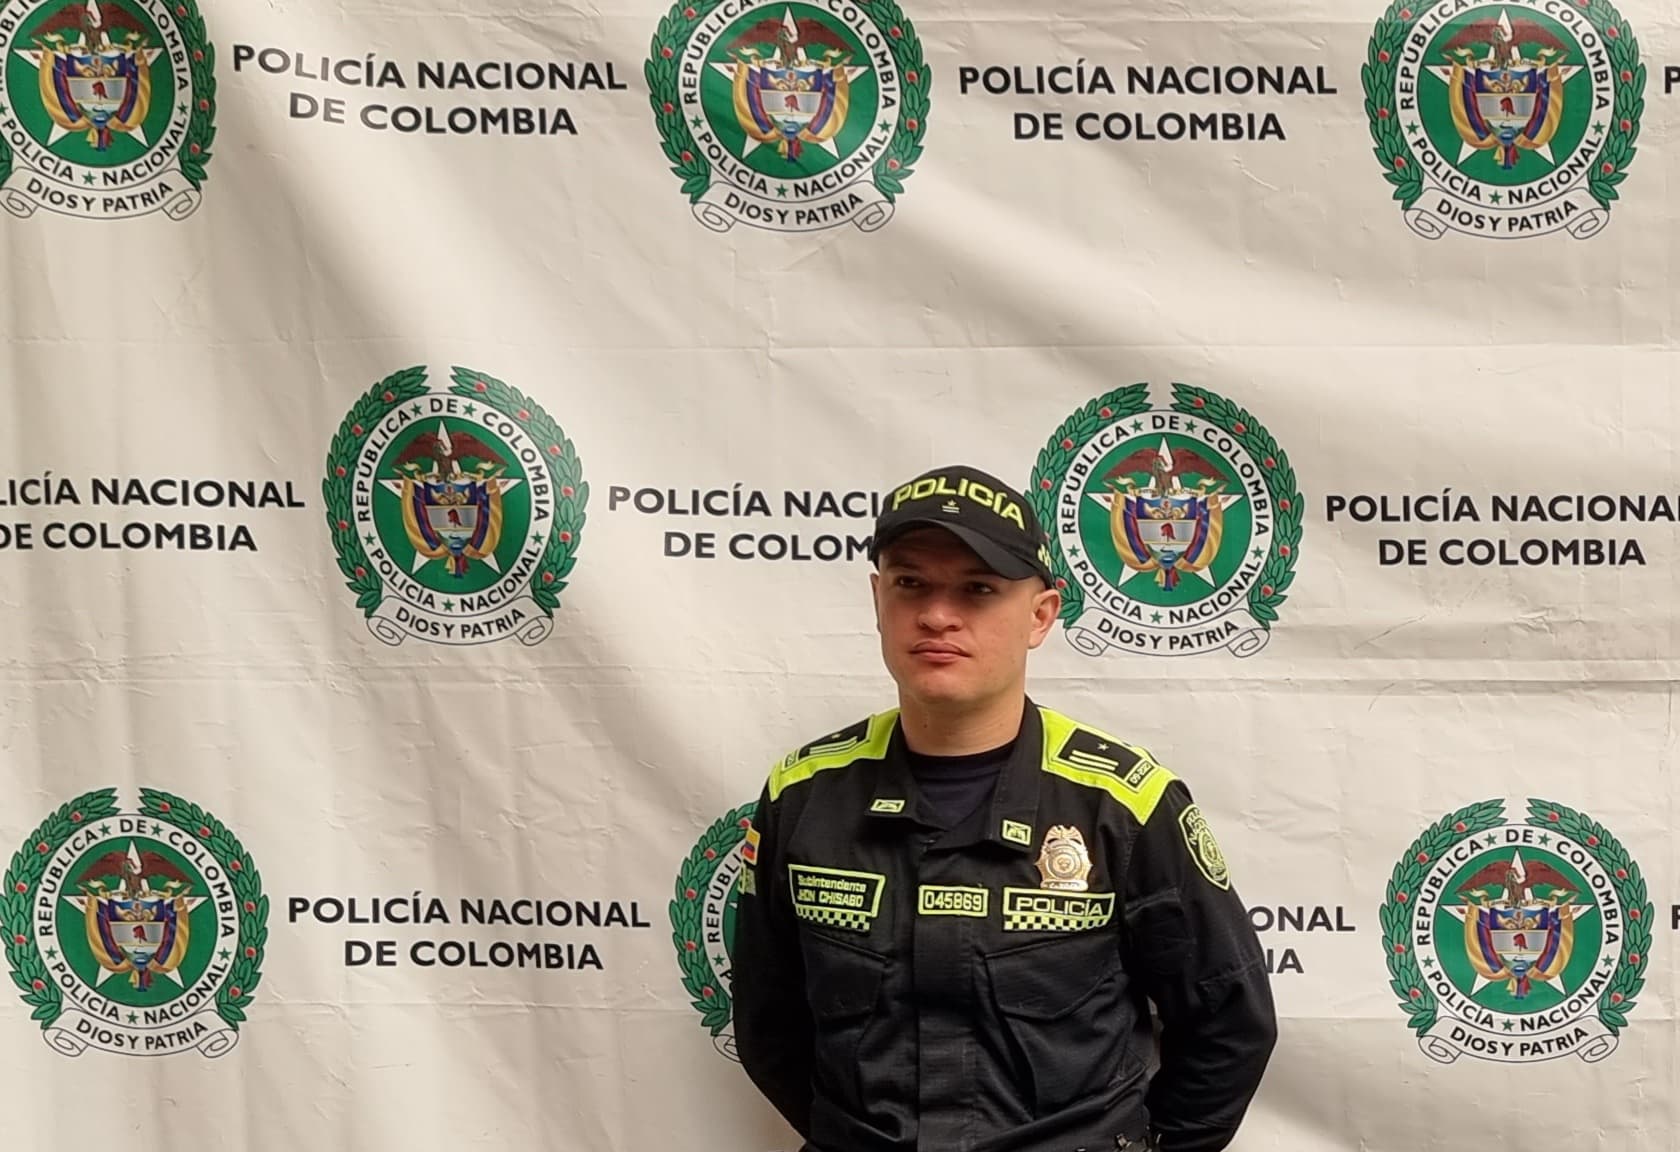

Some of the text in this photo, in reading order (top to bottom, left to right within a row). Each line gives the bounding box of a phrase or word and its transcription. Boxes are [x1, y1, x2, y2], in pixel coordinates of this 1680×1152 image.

[233, 44, 628, 91] POLICÍA NACIONAL
[959, 58, 1338, 95] POLICÍA NACIONAL
[289, 92, 579, 136] DE COLOMBIA
[1013, 112, 1286, 141] DE COLOMBIA
[1508, 137, 1601, 204] NACIONAL
[1437, 199, 1486, 229] DIOS
[1508, 200, 1578, 232] PATRIA
[431, 399, 457, 413] DE
[483, 412, 549, 521] COLOMBIA
[91, 478, 306, 508] NACIONAL
[609, 482, 878, 518] POLICÍA NACI
[892, 476, 1025, 530] POLICÍA
[1326, 487, 1481, 523] POLICÍA
[42, 522, 258, 552] COLOMBIA
[664, 531, 874, 561] DE COLOM
[1378, 538, 1646, 566] DE COLOMBIA
[461, 547, 540, 613] NACIONAL
[396, 608, 439, 636] DIOS
[461, 608, 525, 638] PATRIA
[925, 891, 982, 911] 045869
[1506, 830, 1533, 843] DE
[1557, 842, 1618, 944] COLOMBIA
[288, 890, 651, 928] POLICÍA NACIONAL
[1016, 897, 1103, 916] POLICÍA
[344, 940, 604, 971] DE COLOMBIA
[1520, 969, 1610, 1031] NACIONAL
[1450, 1027, 1498, 1055] DIOS
[1520, 1027, 1588, 1056] PATRIA
